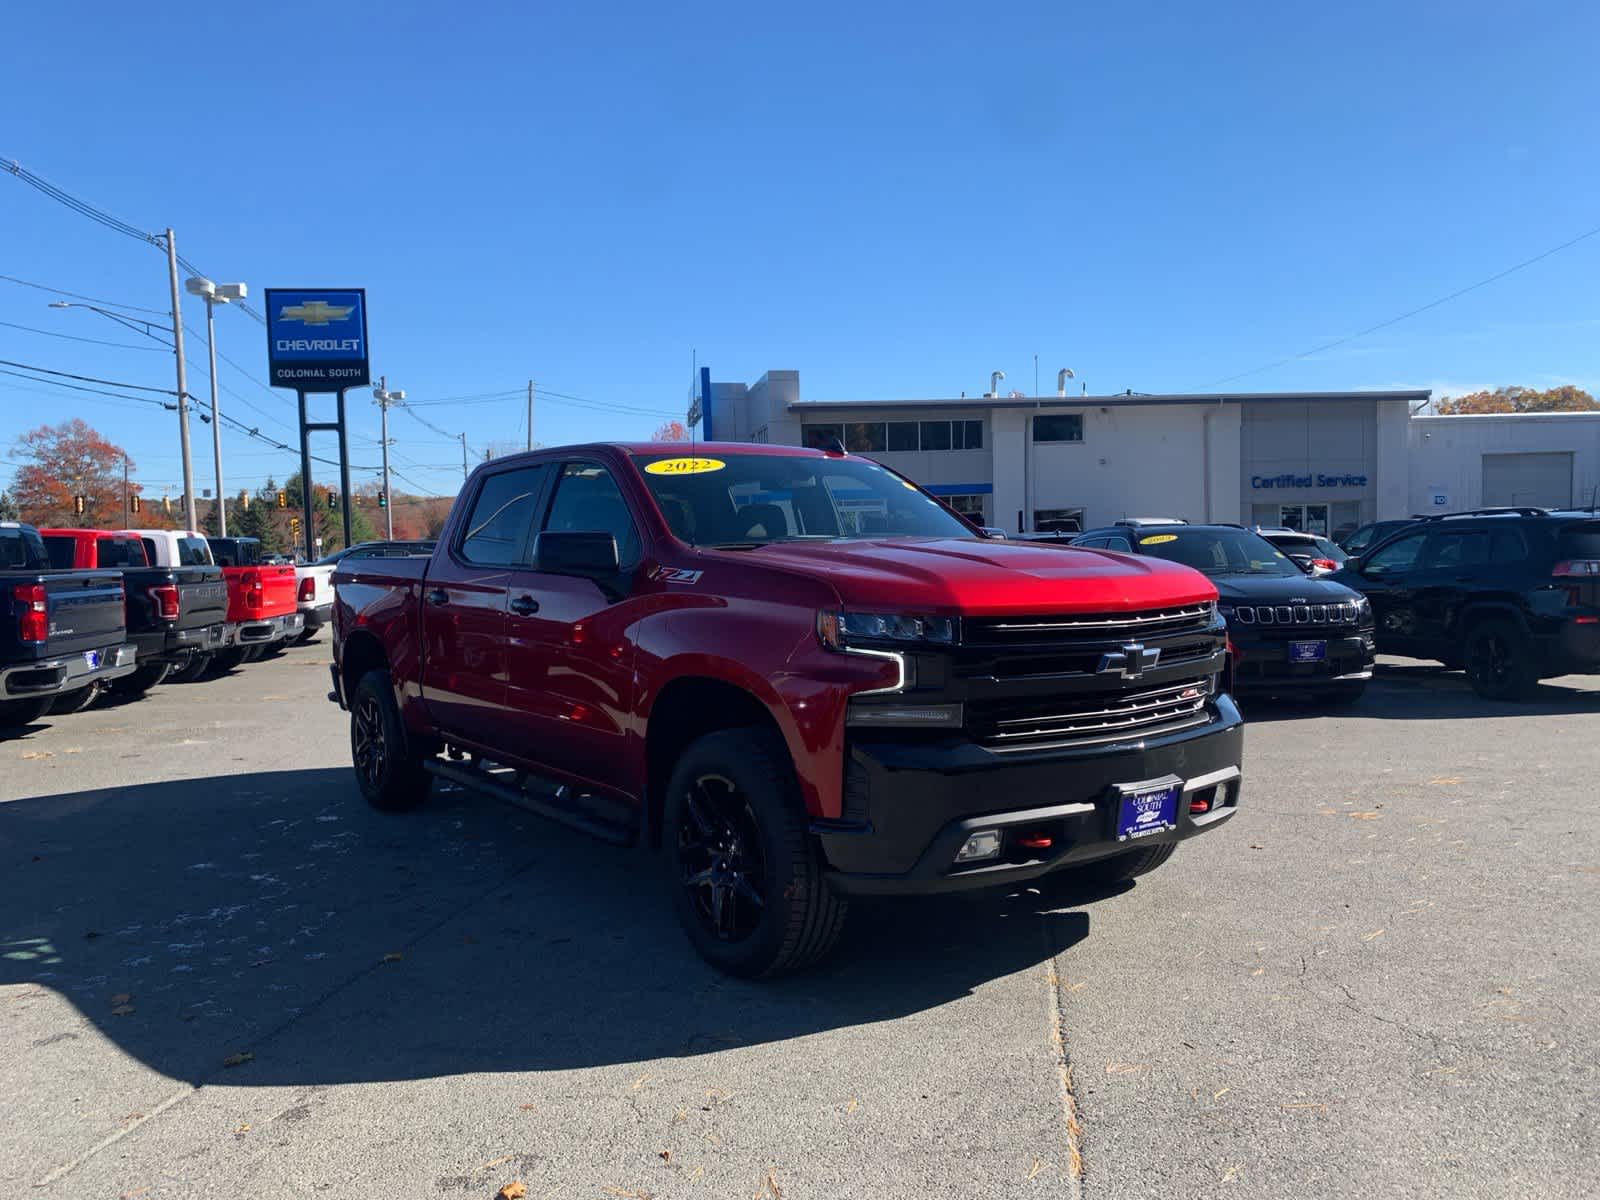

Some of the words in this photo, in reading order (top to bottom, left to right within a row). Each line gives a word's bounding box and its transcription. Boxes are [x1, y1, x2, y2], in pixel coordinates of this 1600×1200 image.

[276, 339, 360, 351] CHEVROLET
[277, 368, 326, 378] COLONIAL
[329, 368, 361, 377] SOUTH
[663, 460, 711, 473] 2022
[1251, 473, 1313, 489] Certified
[1316, 473, 1368, 488] Service
[1132, 791, 1168, 806] COLONIAL
[1136, 801, 1162, 814] SOUTH
